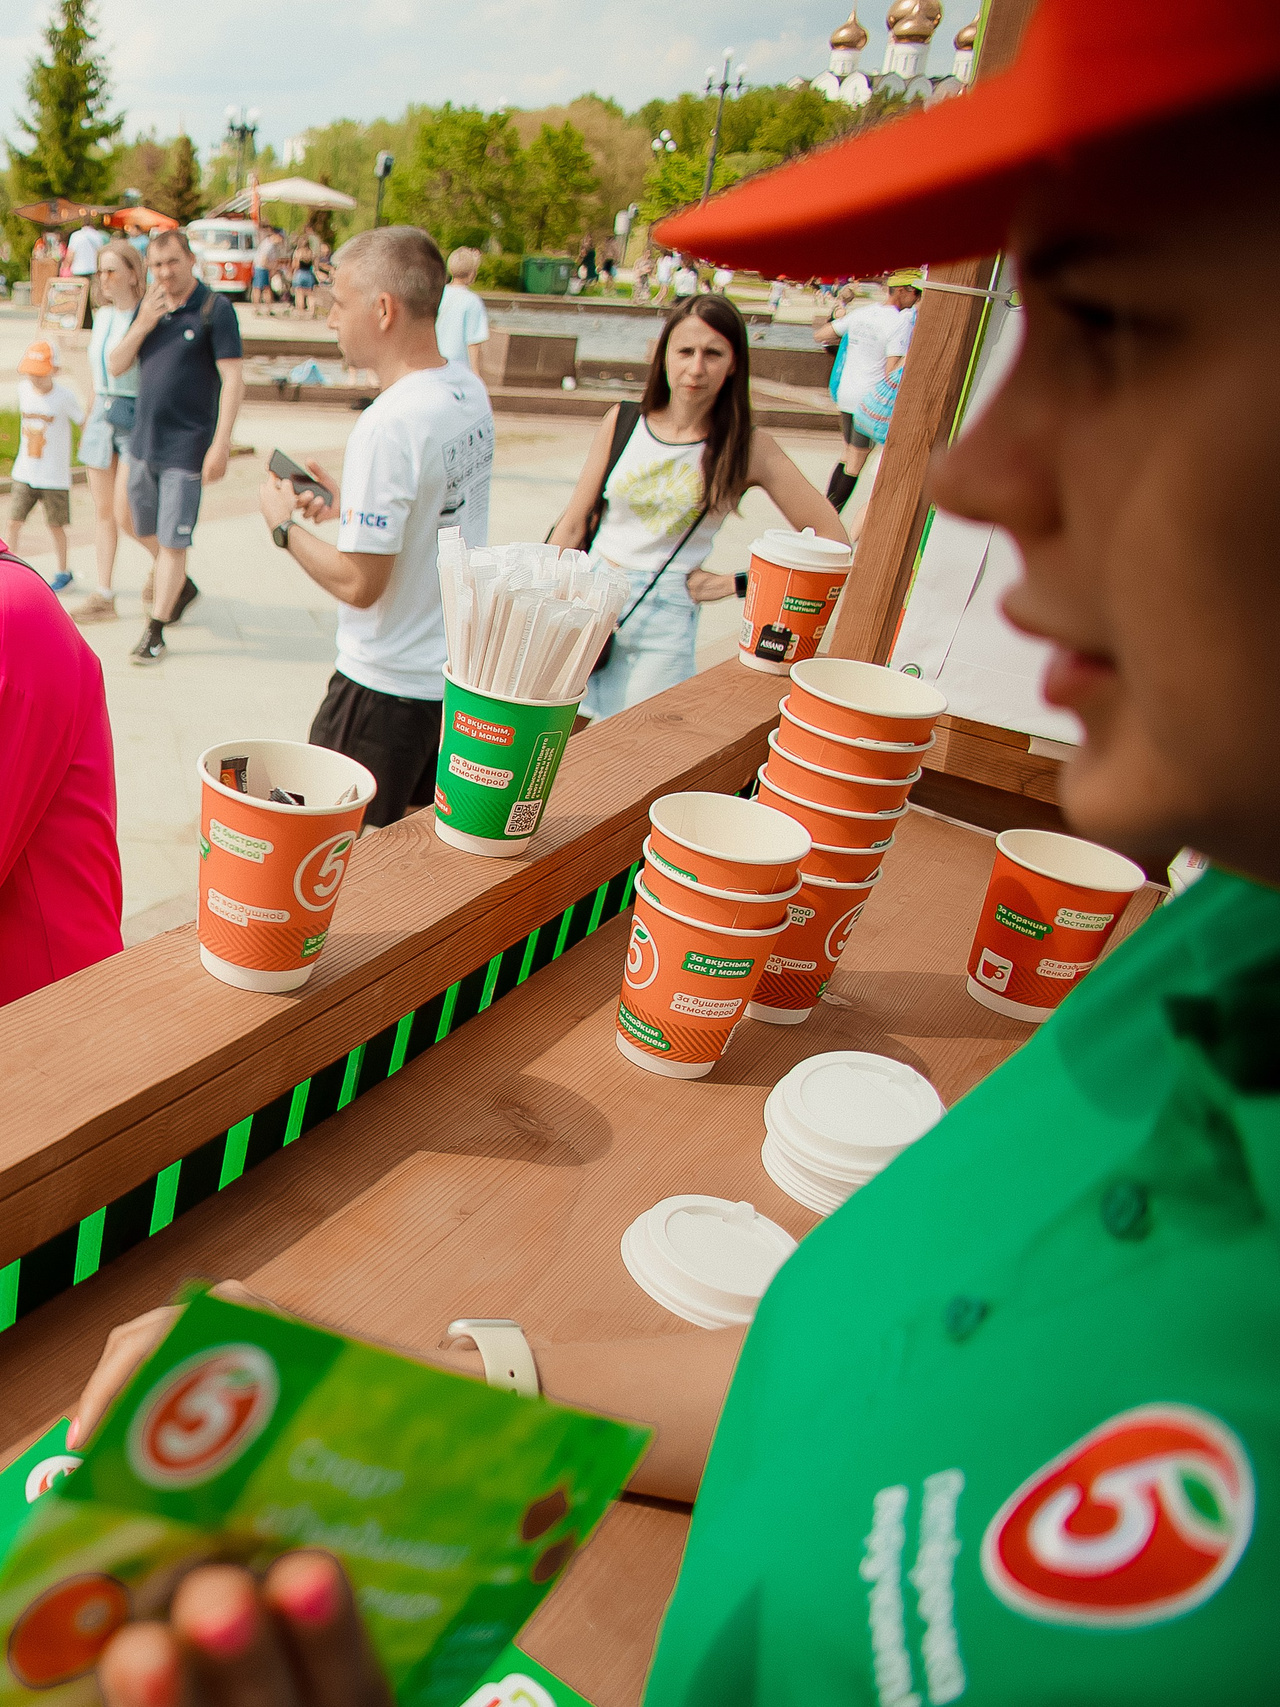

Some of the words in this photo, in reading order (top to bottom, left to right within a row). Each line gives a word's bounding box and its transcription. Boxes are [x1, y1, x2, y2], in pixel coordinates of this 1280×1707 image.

[455, 723, 470, 734] как
[470, 729, 477, 738] у
[478, 731, 507, 744] мамы
[456, 712, 466, 723] За
[467, 718, 511, 737] вкусным,
[450, 765, 505, 788] атмосферой
[452, 755, 461, 765] За
[462, 759, 509, 779] душевной
[211, 822, 221, 834] За
[222, 828, 268, 851] быстрой
[313, 840, 352, 898] 5
[210, 890, 220, 902] За
[221, 898, 285, 921] воздушной
[998, 904, 1007, 914] За
[1007, 911, 1047, 932] горячим
[1057, 917, 1105, 930] доставкой
[1060, 909, 1073, 918] За
[1074, 911, 1112, 923] быстрой
[1001, 918, 1036, 937] сытным
[687, 962, 708, 973] как
[709, 968, 717, 976] у
[689, 953, 704, 963] За
[704, 958, 751, 968] вкусным,
[769, 957, 813, 970] здушной
[1043, 960, 1055, 968] За
[1039, 968, 1073, 978] пенкой
[674, 1003, 734, 1017] атмосферой
[676, 994, 690, 1003] За
[692, 998, 739, 1008] душевной
[625, 1012, 659, 1038] сладким
[154, 1366, 257, 1468] 5
